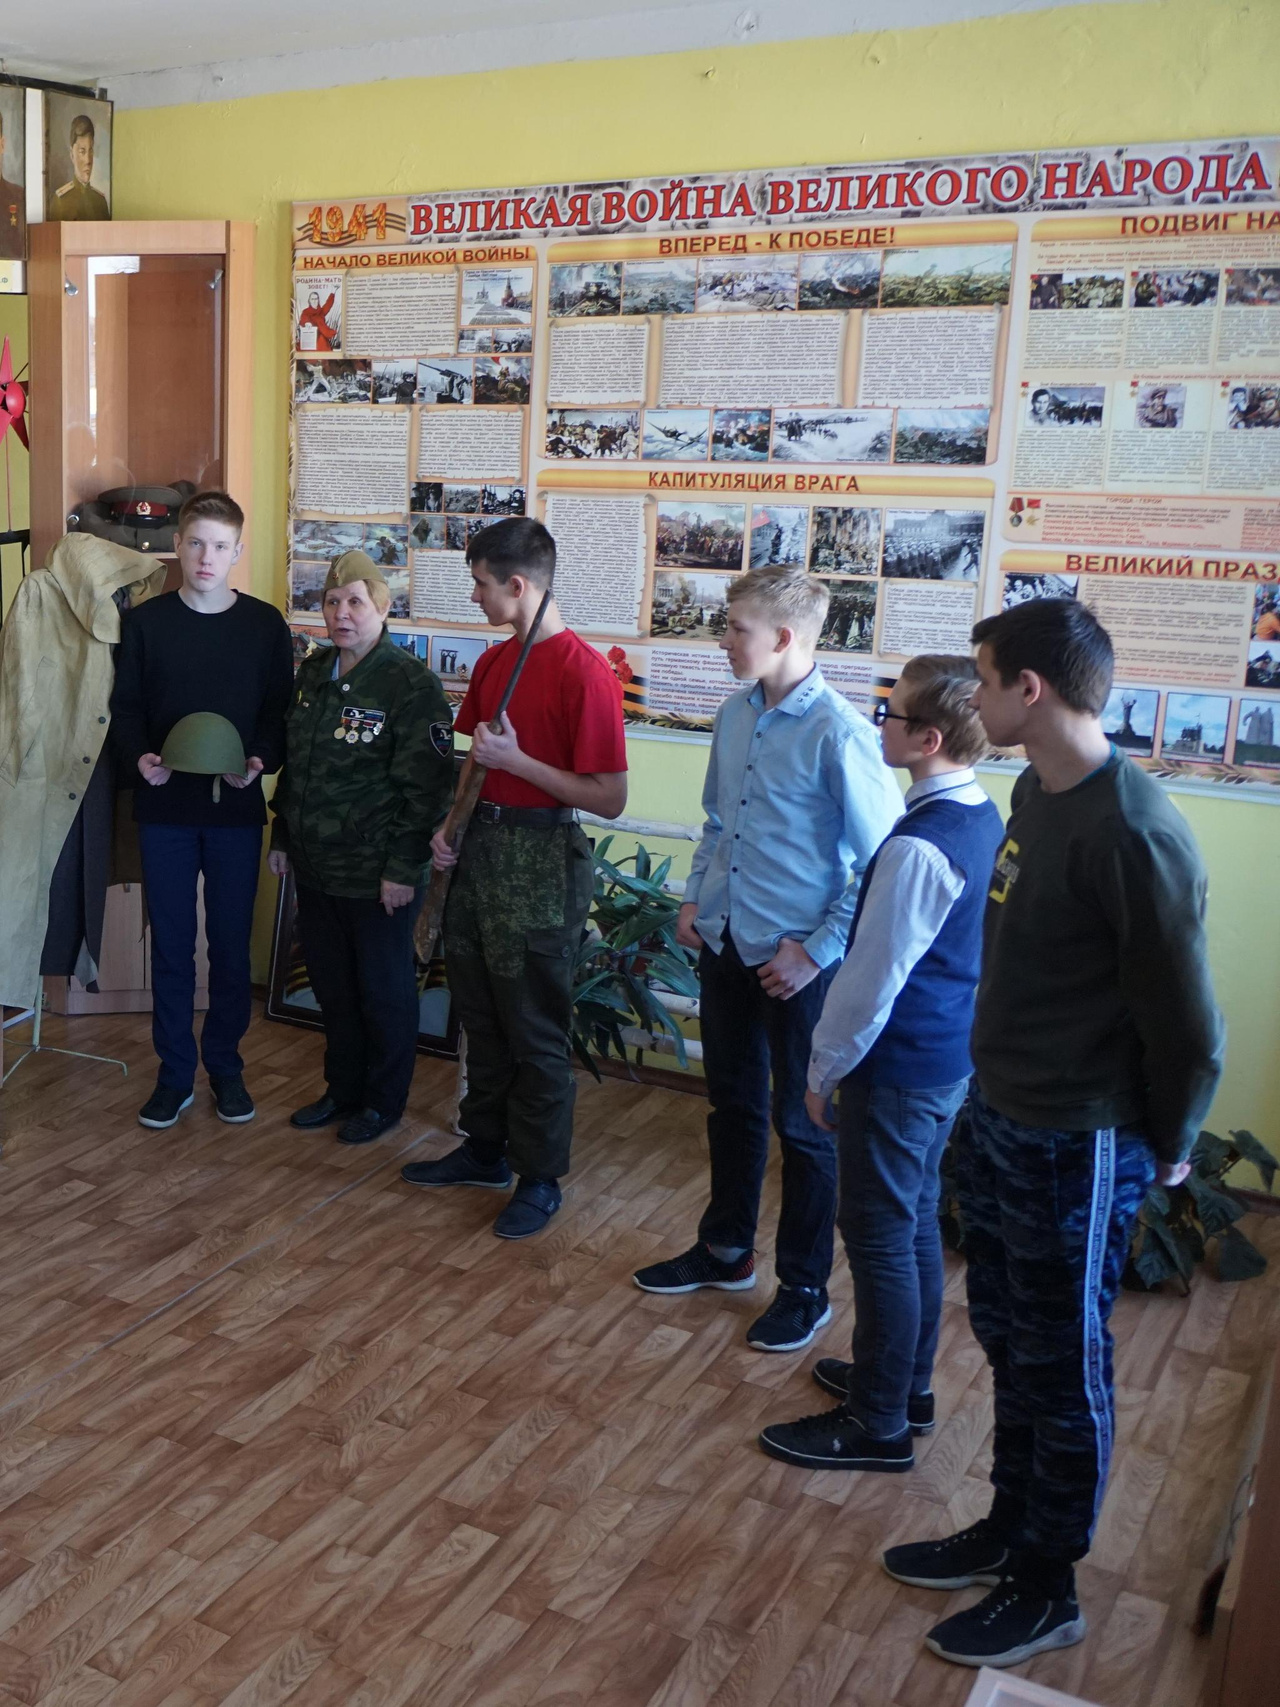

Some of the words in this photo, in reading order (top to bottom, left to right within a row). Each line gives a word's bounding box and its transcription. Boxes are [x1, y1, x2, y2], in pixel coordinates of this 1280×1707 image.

[307, 202, 387, 242] 1941
[410, 194, 592, 236] ВЕЛИКАЯ
[601, 180, 756, 224] ВОЙНА
[769, 164, 1029, 216] ВЕЛИКОГО
[1040, 152, 1271, 202] НАРОДА
[1120, 212, 1239, 237] ПОДВИГ
[659, 234, 748, 255] ВПЕРЕД
[769, 233, 782, 250] К
[789, 227, 896, 249] ПОБЕДЕ!
[303, 252, 372, 269] НАЧАЛО
[376, 248, 458, 267] ВЕЛИКОЙ
[463, 246, 529, 262] ВОЙНЫ
[648, 471, 787, 492] КАПИТУЛЯЦИЯ
[794, 475, 860, 493] ВРАГА
[1065, 554, 1193, 577] ВЕЛИКИЙ
[1203, 561, 1280, 583] ПРАЗ
